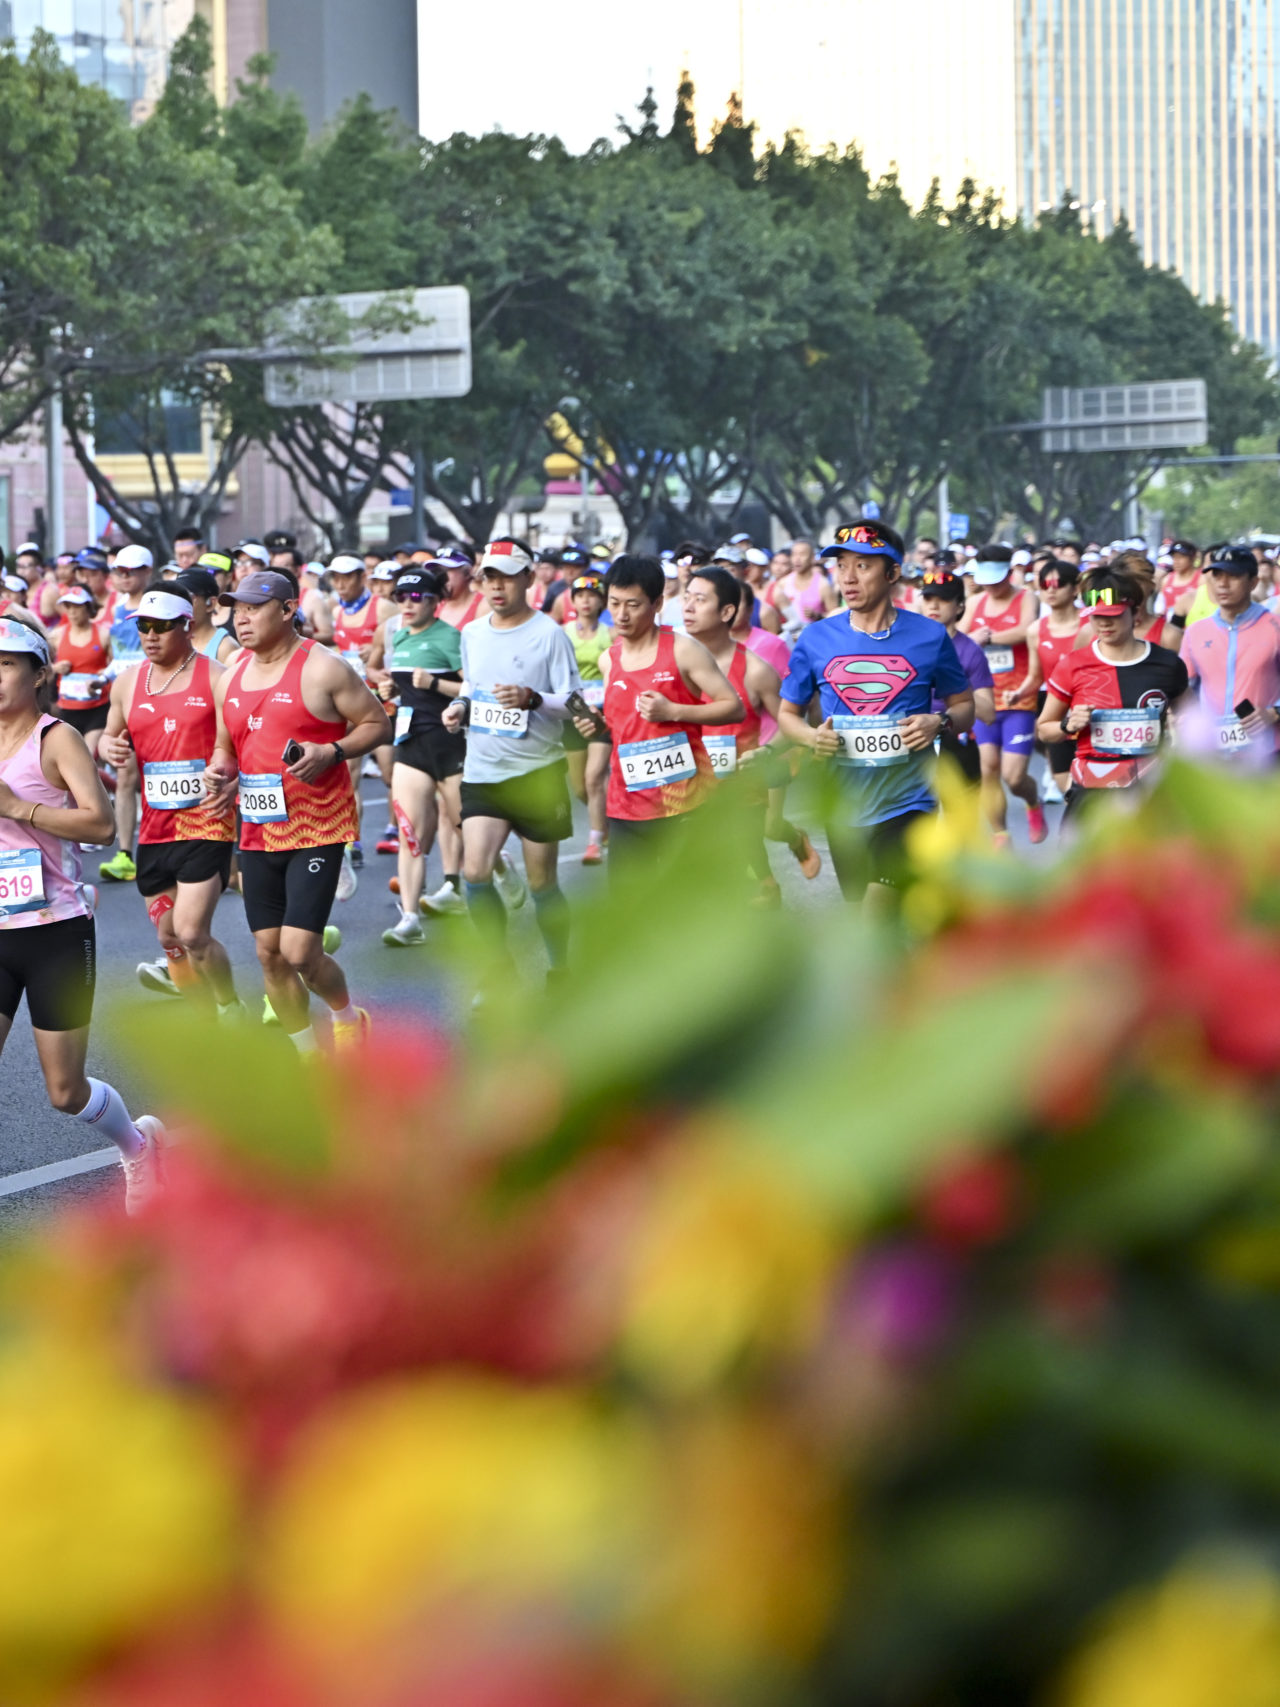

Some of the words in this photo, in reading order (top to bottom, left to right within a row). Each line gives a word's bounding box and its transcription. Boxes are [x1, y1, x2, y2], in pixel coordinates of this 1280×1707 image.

[485, 708, 522, 727] 0762
[855, 733, 901, 753] 0860
[1096, 729, 1104, 738] D
[1112, 726, 1155, 743] 9246
[626, 763, 635, 773] D
[644, 751, 686, 775] 2144
[148, 781, 154, 791] D
[160, 778, 201, 796] 0403
[244, 793, 278, 810] 2088
